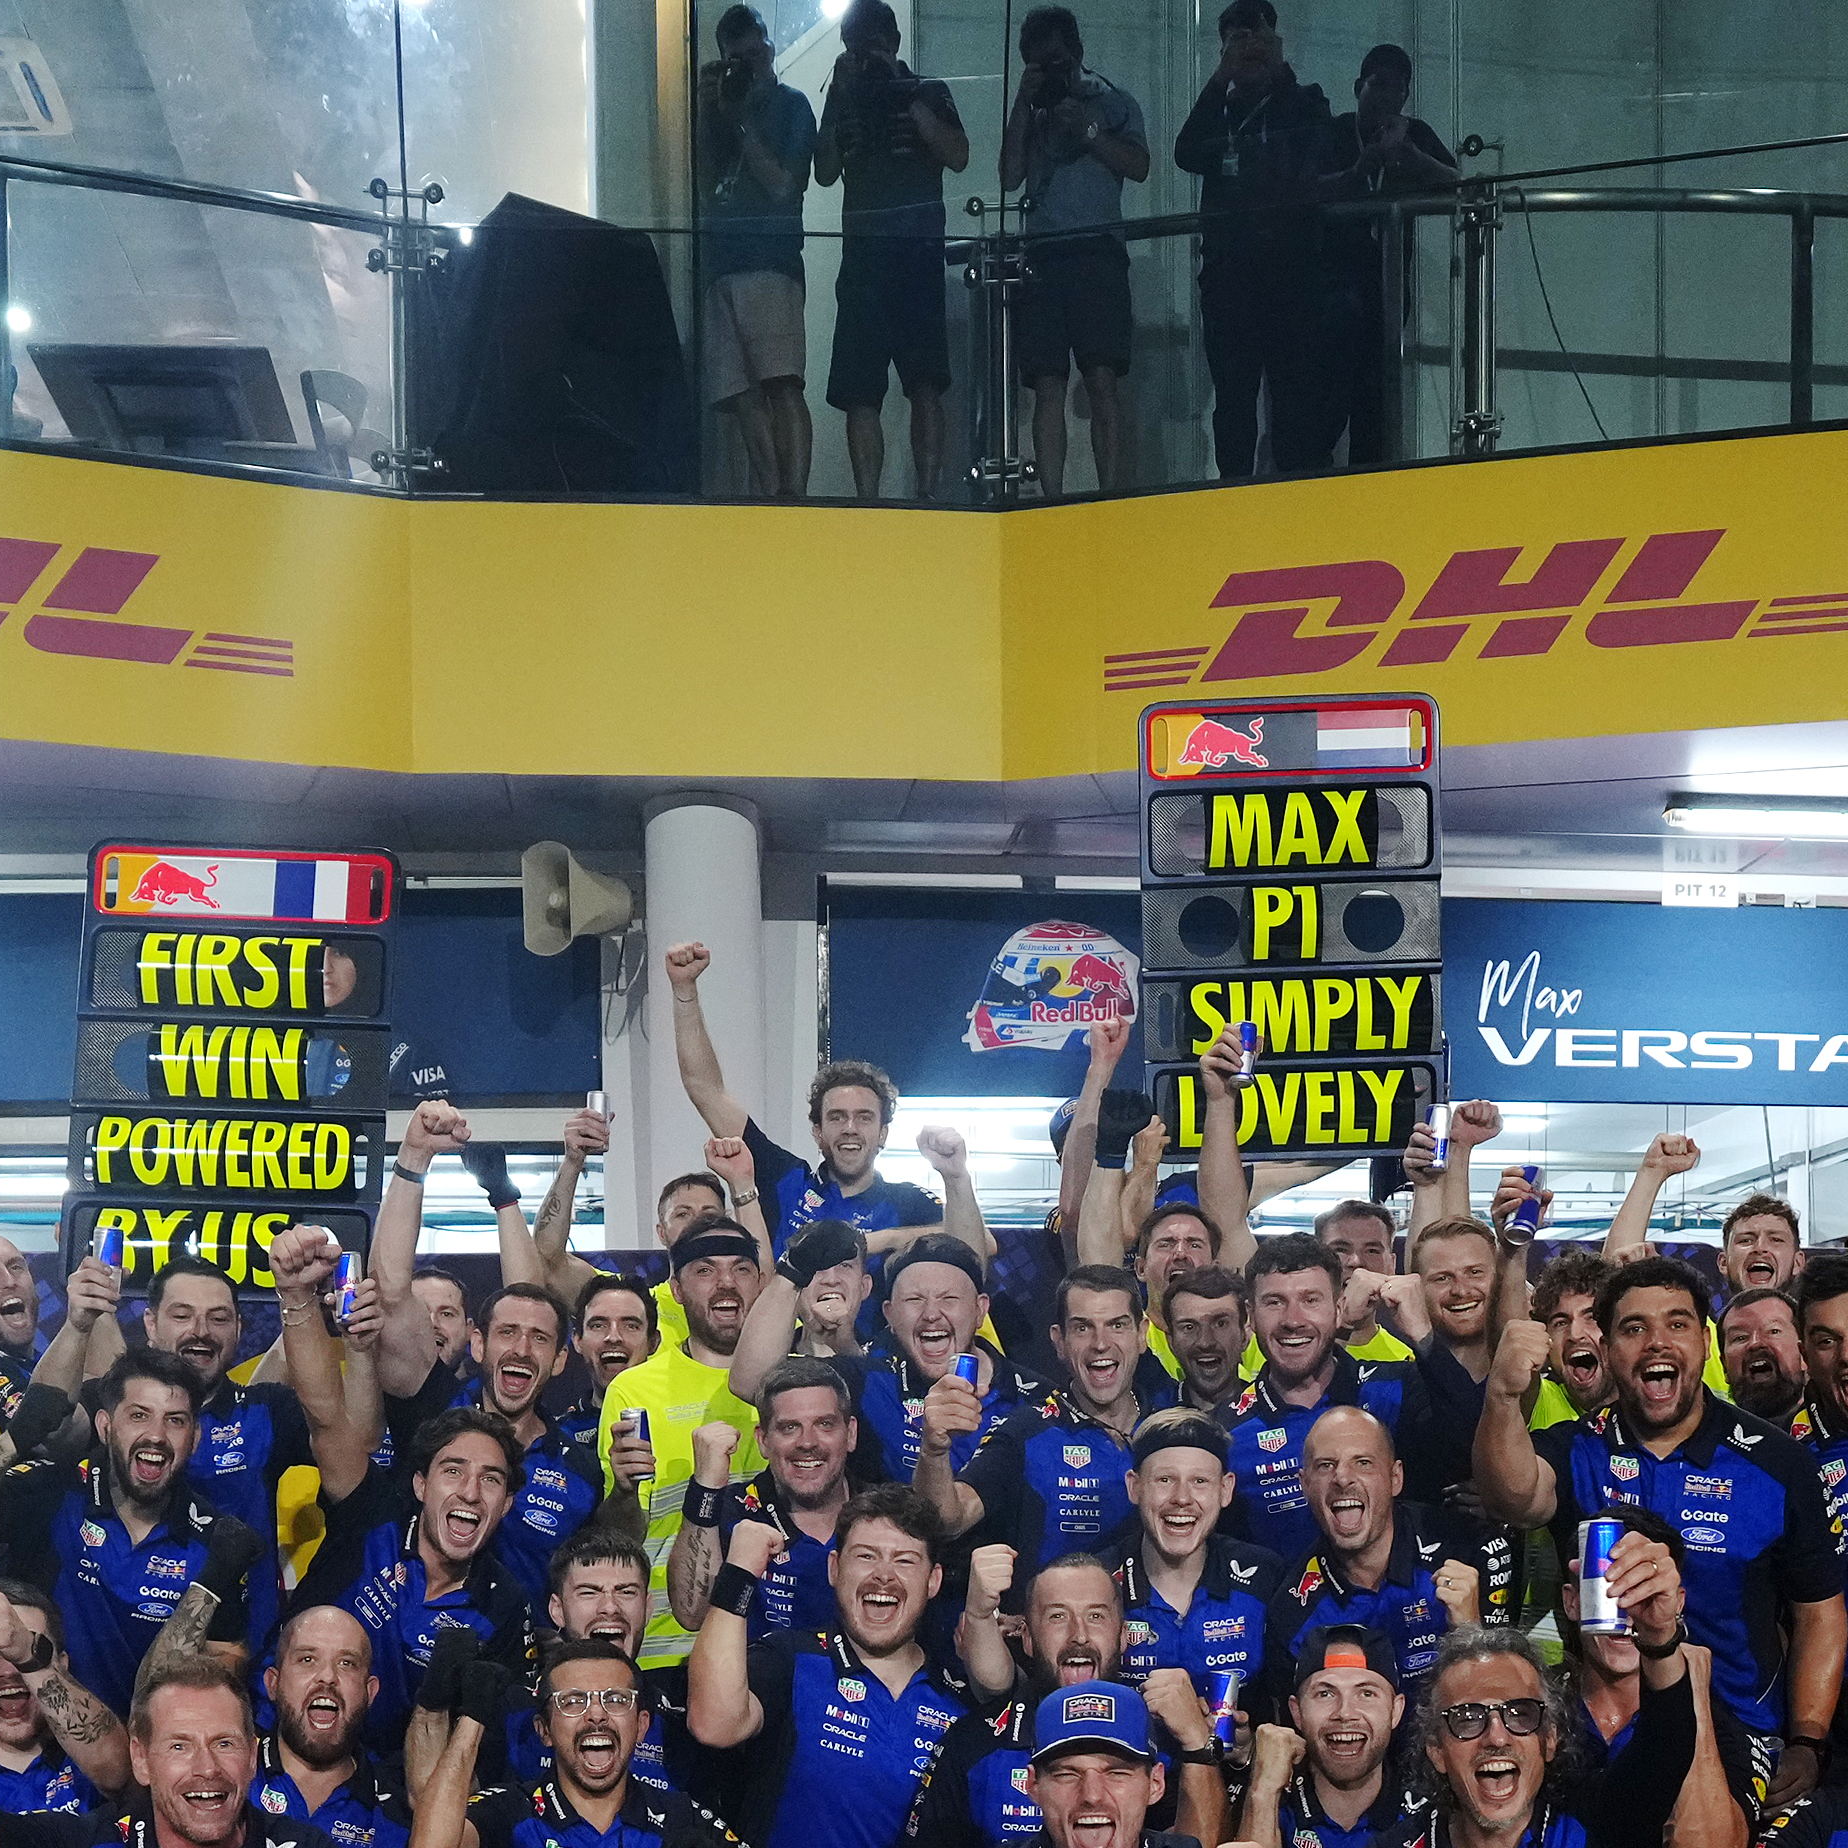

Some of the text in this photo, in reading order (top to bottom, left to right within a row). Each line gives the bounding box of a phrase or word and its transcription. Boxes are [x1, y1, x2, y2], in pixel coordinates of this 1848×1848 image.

[1202, 530, 1760, 683] DHL
[1208, 790, 1368, 868] MAX
[1675, 884, 1727, 898] PIT 12
[1252, 886, 1318, 960] P1
[139, 932, 322, 1009] FIRST
[1477, 950, 1583, 1041] Max
[1030, 997, 1120, 1023] Red Bull
[1190, 976, 1422, 1055] SIMPLY
[160, 1024, 305, 1100] WIN
[412, 1065, 446, 1086] VISA
[97, 1116, 350, 1190] POWERED
[1259, 1429, 1285, 1441] TAG
[1065, 1446, 1089, 1456] TAG
[1064, 1455, 1091, 1468] HEUER
[1255, 1460, 1287, 1476] Mobil
[1612, 1456, 1639, 1468] TAG
[1058, 1476, 1088, 1489] Mobil
[1684, 1474, 1734, 1487] ORACLE
[1058, 1493, 1100, 1503] ORACLE
[1682, 1490, 1732, 1500] RACING
[535, 1496, 565, 1513] Gate
[1059, 1508, 1101, 1517] CARLYLE
[1692, 1510, 1730, 1524] Gate
[1480, 1536, 1509, 1555] VISA
[150, 1587, 182, 1601] Gate
[363, 1585, 393, 1622] CARLYLE
[1203, 1616, 1245, 1629] ORACLE
[1216, 1651, 1248, 1665] Gate
[840, 1678, 866, 1691] TAG
[1067, 1696, 1111, 1708] ORACLE
[825, 1704, 858, 1726] Mobil
[917, 1704, 958, 1724] ORACLE
[822, 1722, 868, 1742] ORACLE
[820, 1739, 865, 1758] CARLYLE
[1002, 1804, 1036, 1817] Mobil
[334, 1820, 376, 1835] ORACLE
